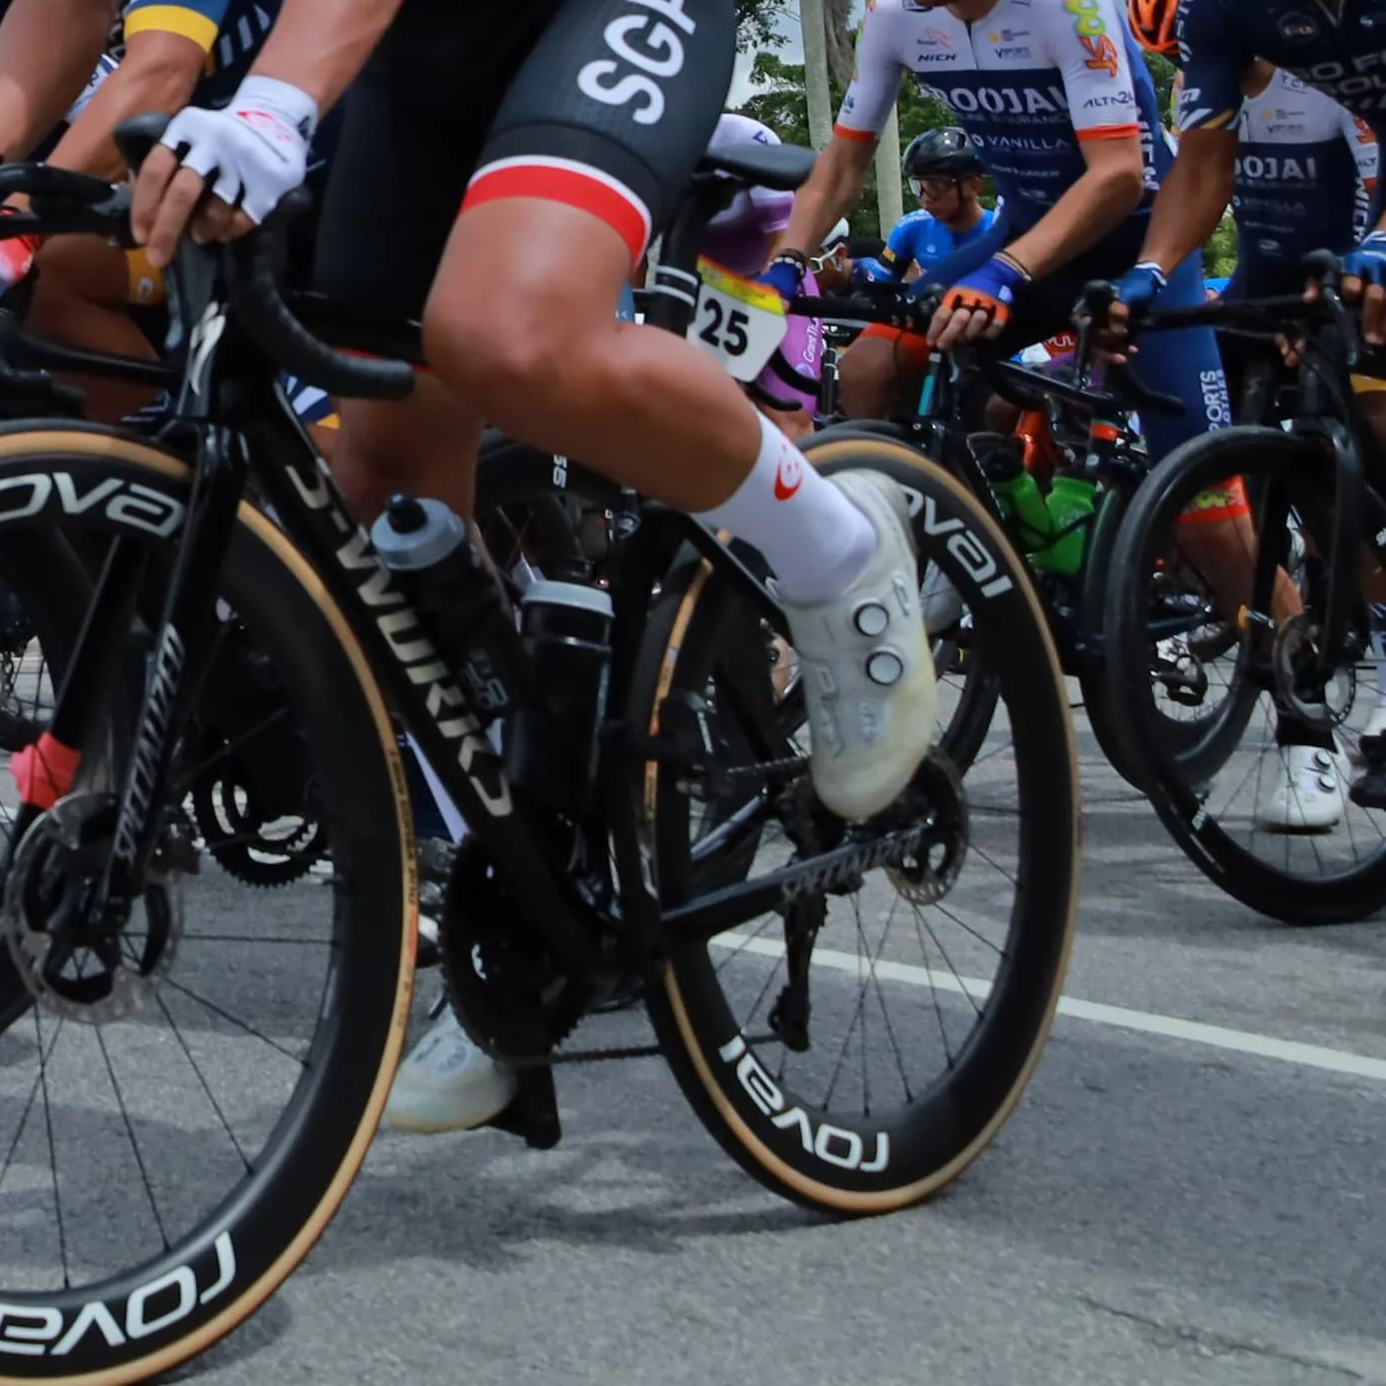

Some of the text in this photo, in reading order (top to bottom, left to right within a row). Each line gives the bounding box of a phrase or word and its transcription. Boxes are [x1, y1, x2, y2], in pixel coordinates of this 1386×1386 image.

[917, 54, 957, 62] NICH
[986, 134, 1069, 150] VANILLA
[698, 299, 749, 356] 25
[718, 1034, 890, 1173] roval
